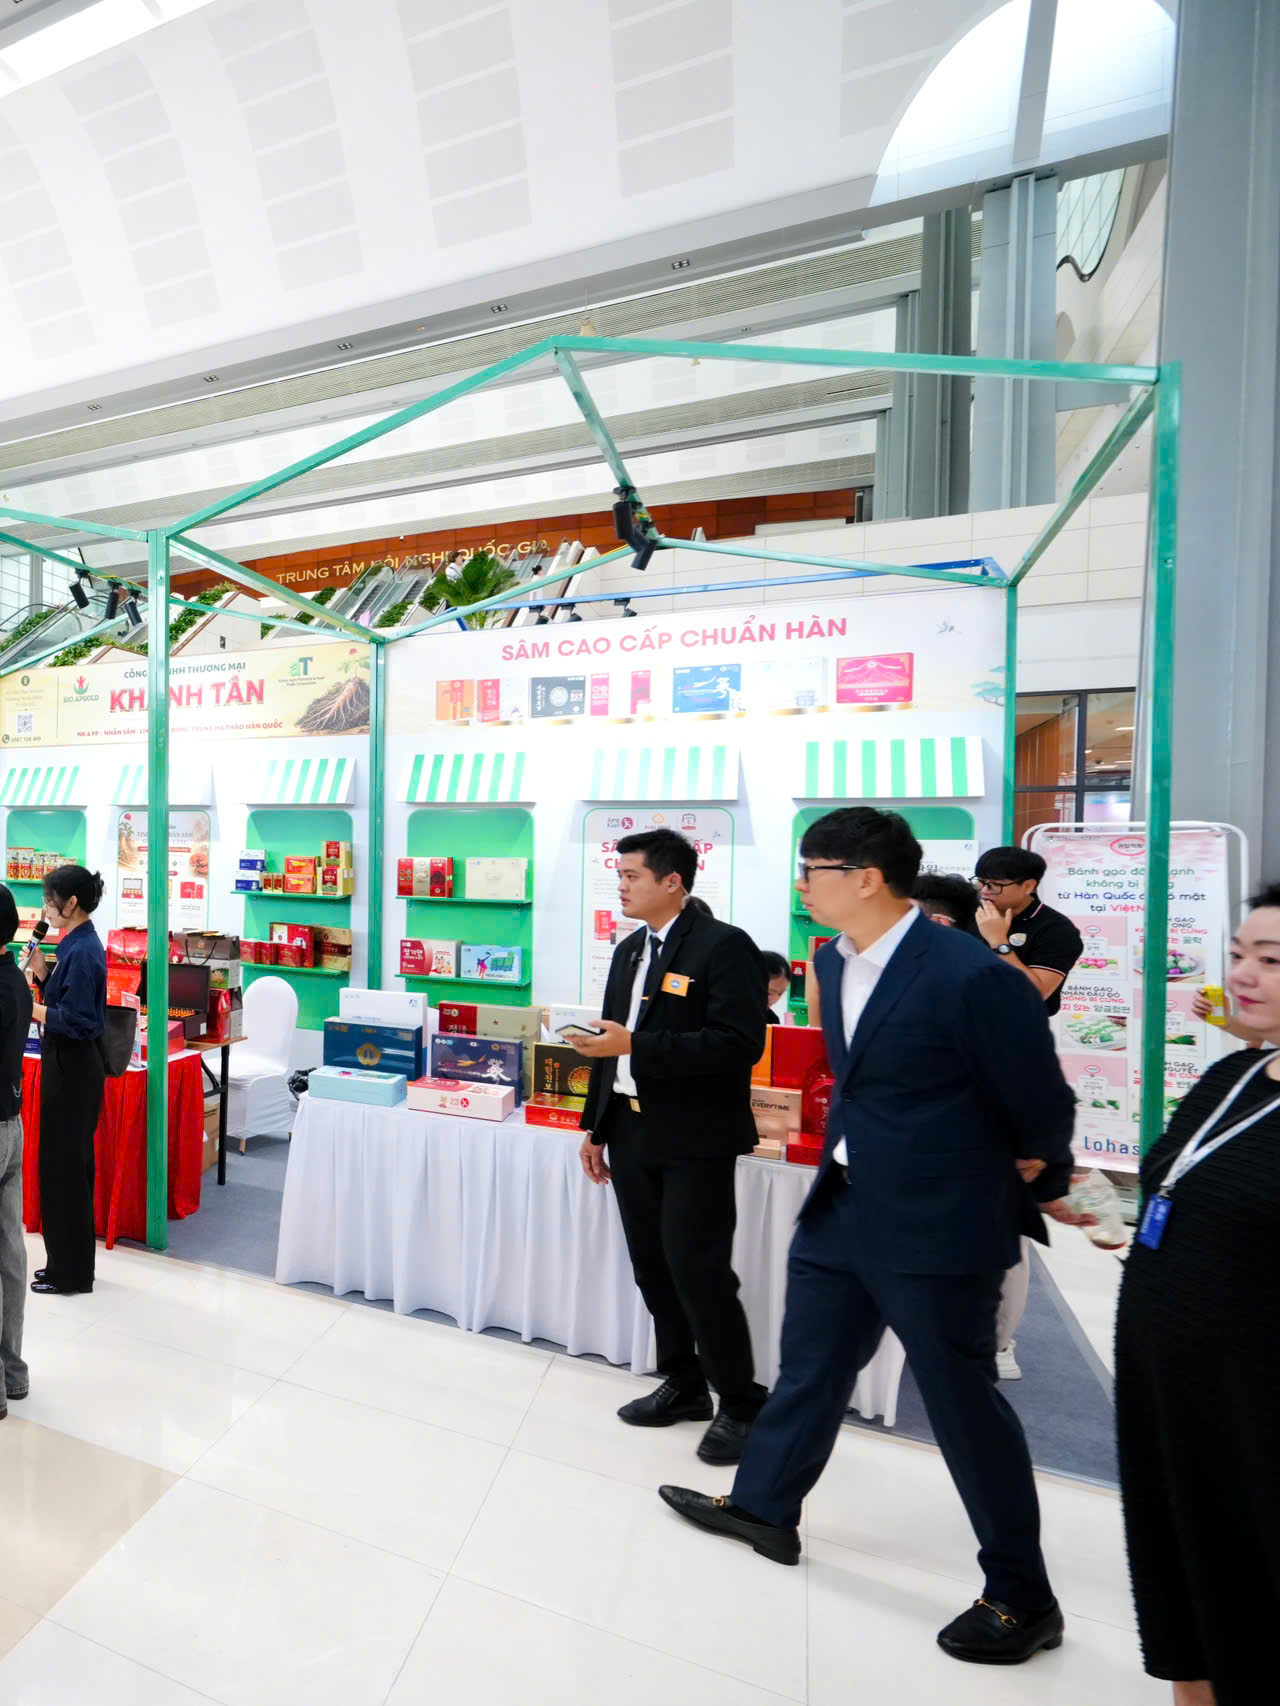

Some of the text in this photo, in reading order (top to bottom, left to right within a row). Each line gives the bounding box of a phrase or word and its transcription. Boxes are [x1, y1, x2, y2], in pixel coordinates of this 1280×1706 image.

[276, 567, 329, 584] TRUNG
[332, 561, 365, 576] TÂM
[501, 614, 847, 661] SÂM CAO CẤP CHUẨN HÀN
[124, 668, 147, 679] CÔNG
[187, 663, 227, 674] THƯƠNG
[228, 661, 246, 673] MẠI
[109, 674, 265, 711] KHNH TÂN
[693, 838, 713, 854] ẤP
[1067, 867, 1099, 876] Bánh
[1103, 868, 1127, 878] gạo
[1086, 879, 1139, 890] không bị
[1058, 891, 1071, 899] từ
[1074, 890, 1099, 900] Hàn
[1103, 890, 1136, 900] Quốc
[1179, 892, 1206, 901] mặt
[1090, 904, 1106, 912] tại
[1067, 984, 1091, 992] BÁNH
[1164, 1066, 1199, 1075] GUYỆT
[1179, 1072, 1201, 1080] CỨN
[752, 1101, 790, 1112] EVERYTIME
[1084, 1136, 1140, 1156] lohas
